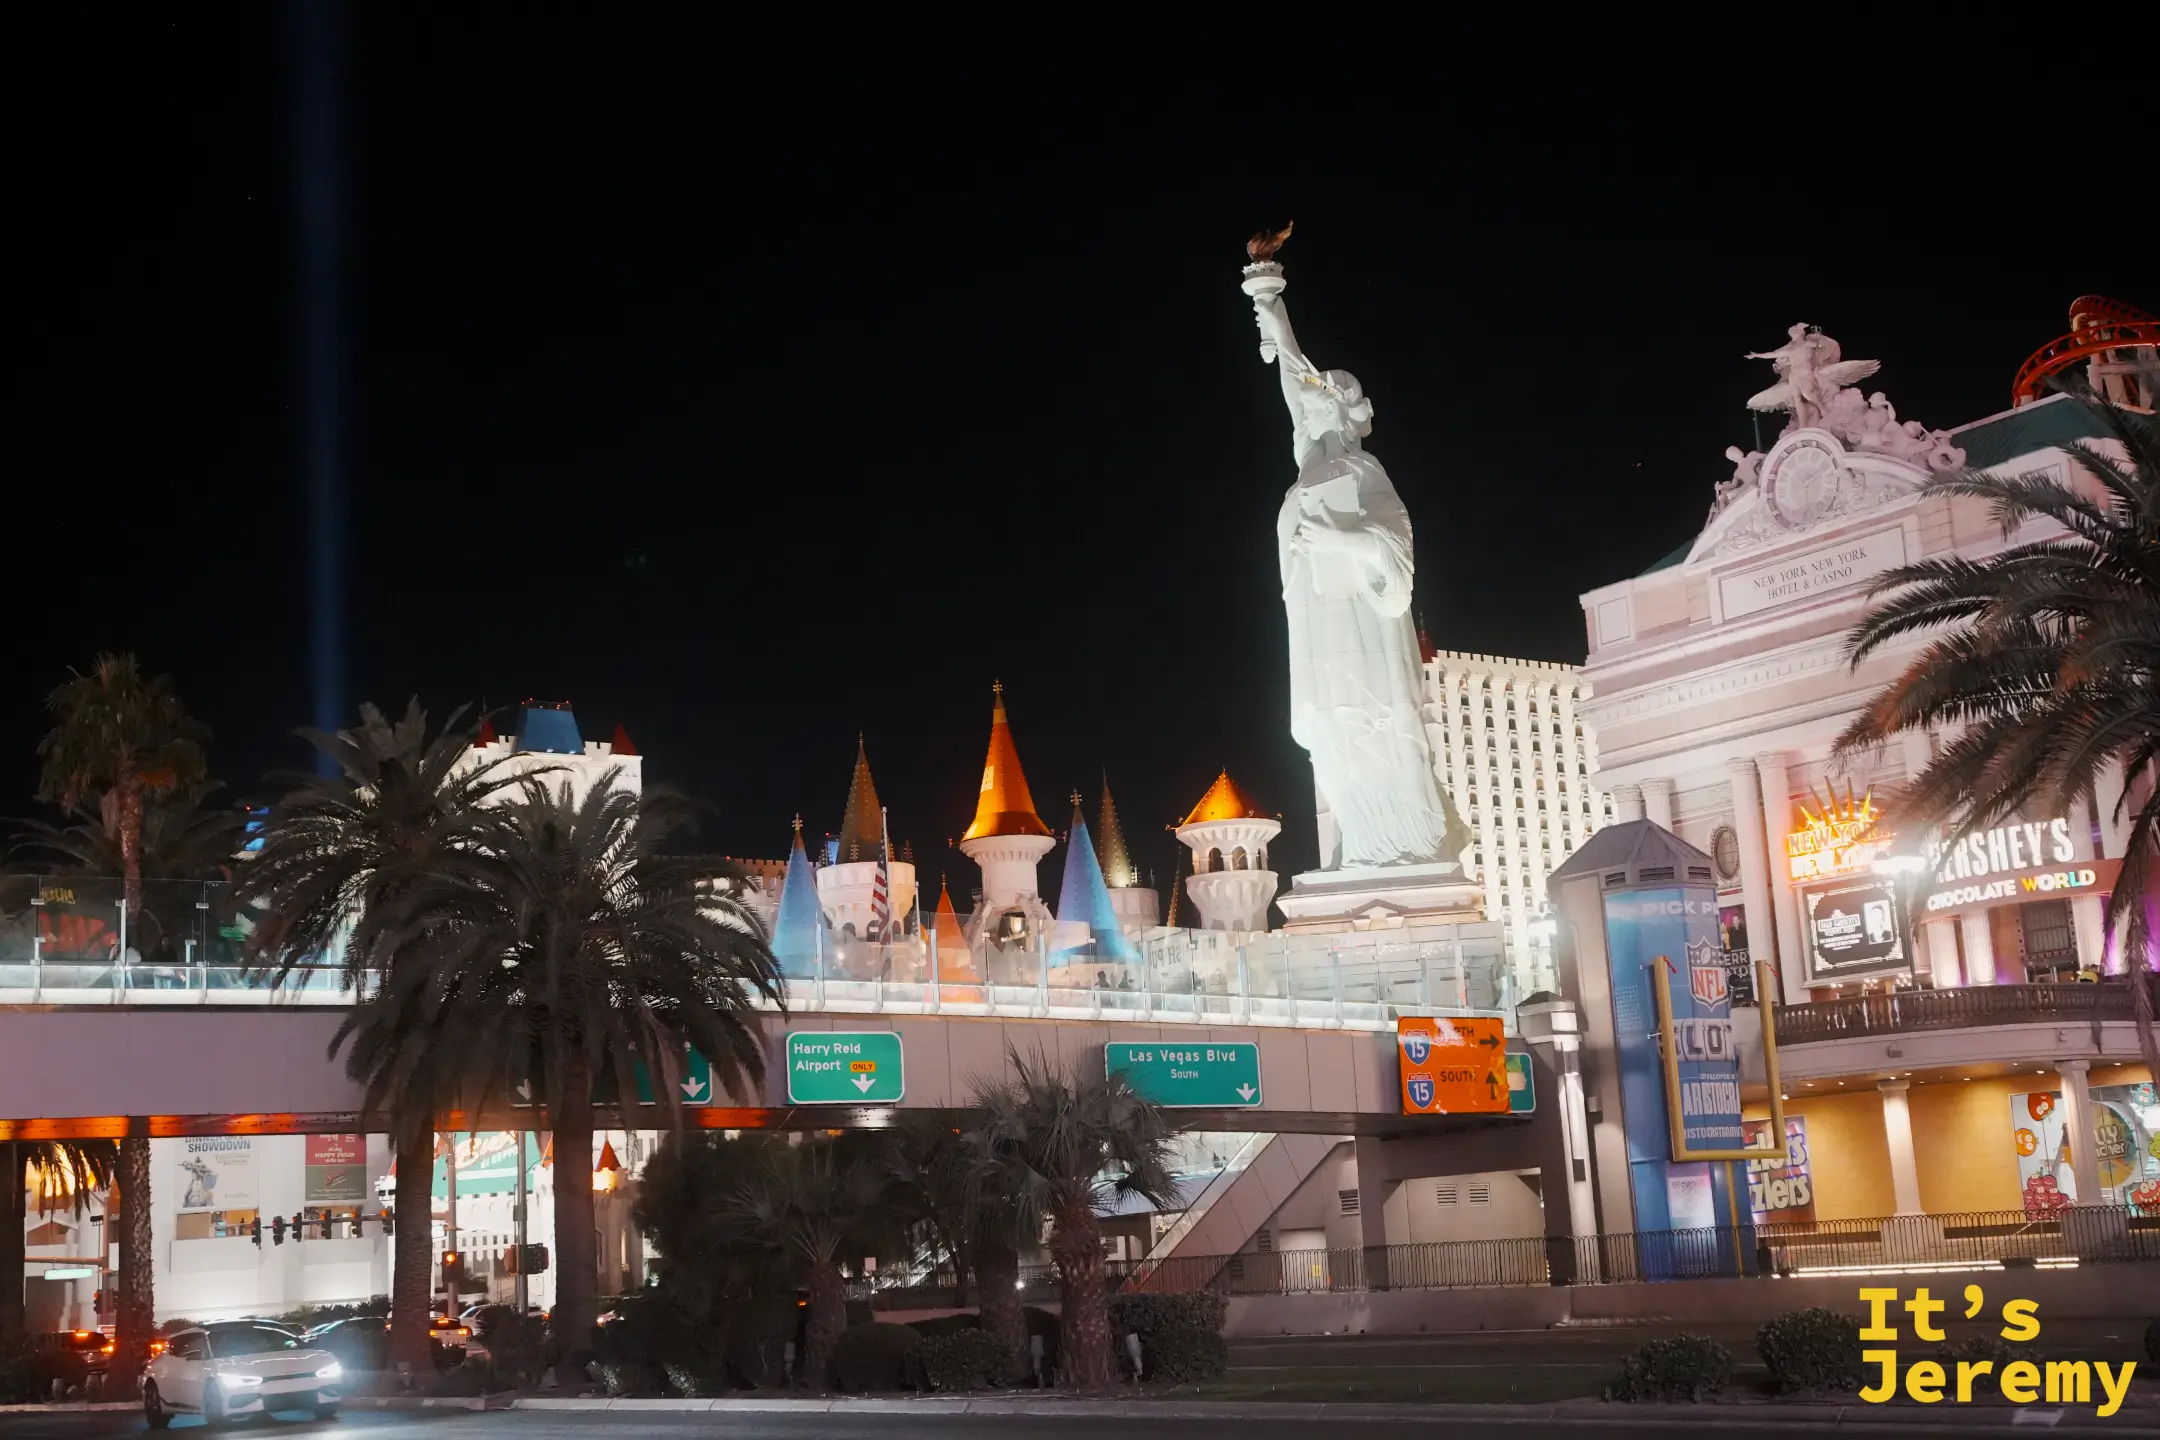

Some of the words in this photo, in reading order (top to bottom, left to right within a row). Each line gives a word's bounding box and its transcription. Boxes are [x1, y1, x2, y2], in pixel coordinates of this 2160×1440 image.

[1753, 574, 1776, 590] NEW
[1780, 565, 1808, 581] YORK
[1811, 557, 1834, 572] NEW
[1838, 547, 1868, 563] YORK
[1768, 582, 1800, 599] HOTEL
[1803, 580, 1811, 590] &
[1814, 566, 1852, 586] CASINO
[1788, 826, 1832, 855] NEW
[1927, 879, 2016, 911] CHOCOLATE
[2020, 869, 2096, 893] WORLD
[1641, 900, 1697, 916] PICK
[1723, 951, 1750, 966] ERR
[1693, 968, 1725, 1000] NFL
[794, 1043, 830, 1056] Harry
[833, 1042, 861, 1054] Reid
[1129, 1049, 1153, 1062] Las
[1160, 1049, 1200, 1065] Vegas
[1206, 1049, 1236, 1062] Blvd
[1411, 1042, 1425, 1058] 15
[795, 1060, 841, 1073] Airport
[1170, 1068, 1198, 1079] SOUTH
[1440, 1071, 1476, 1082] SOUTH
[1413, 1082, 1429, 1101] 15
[188, 1140, 250, 1153] SHOWDOWN
